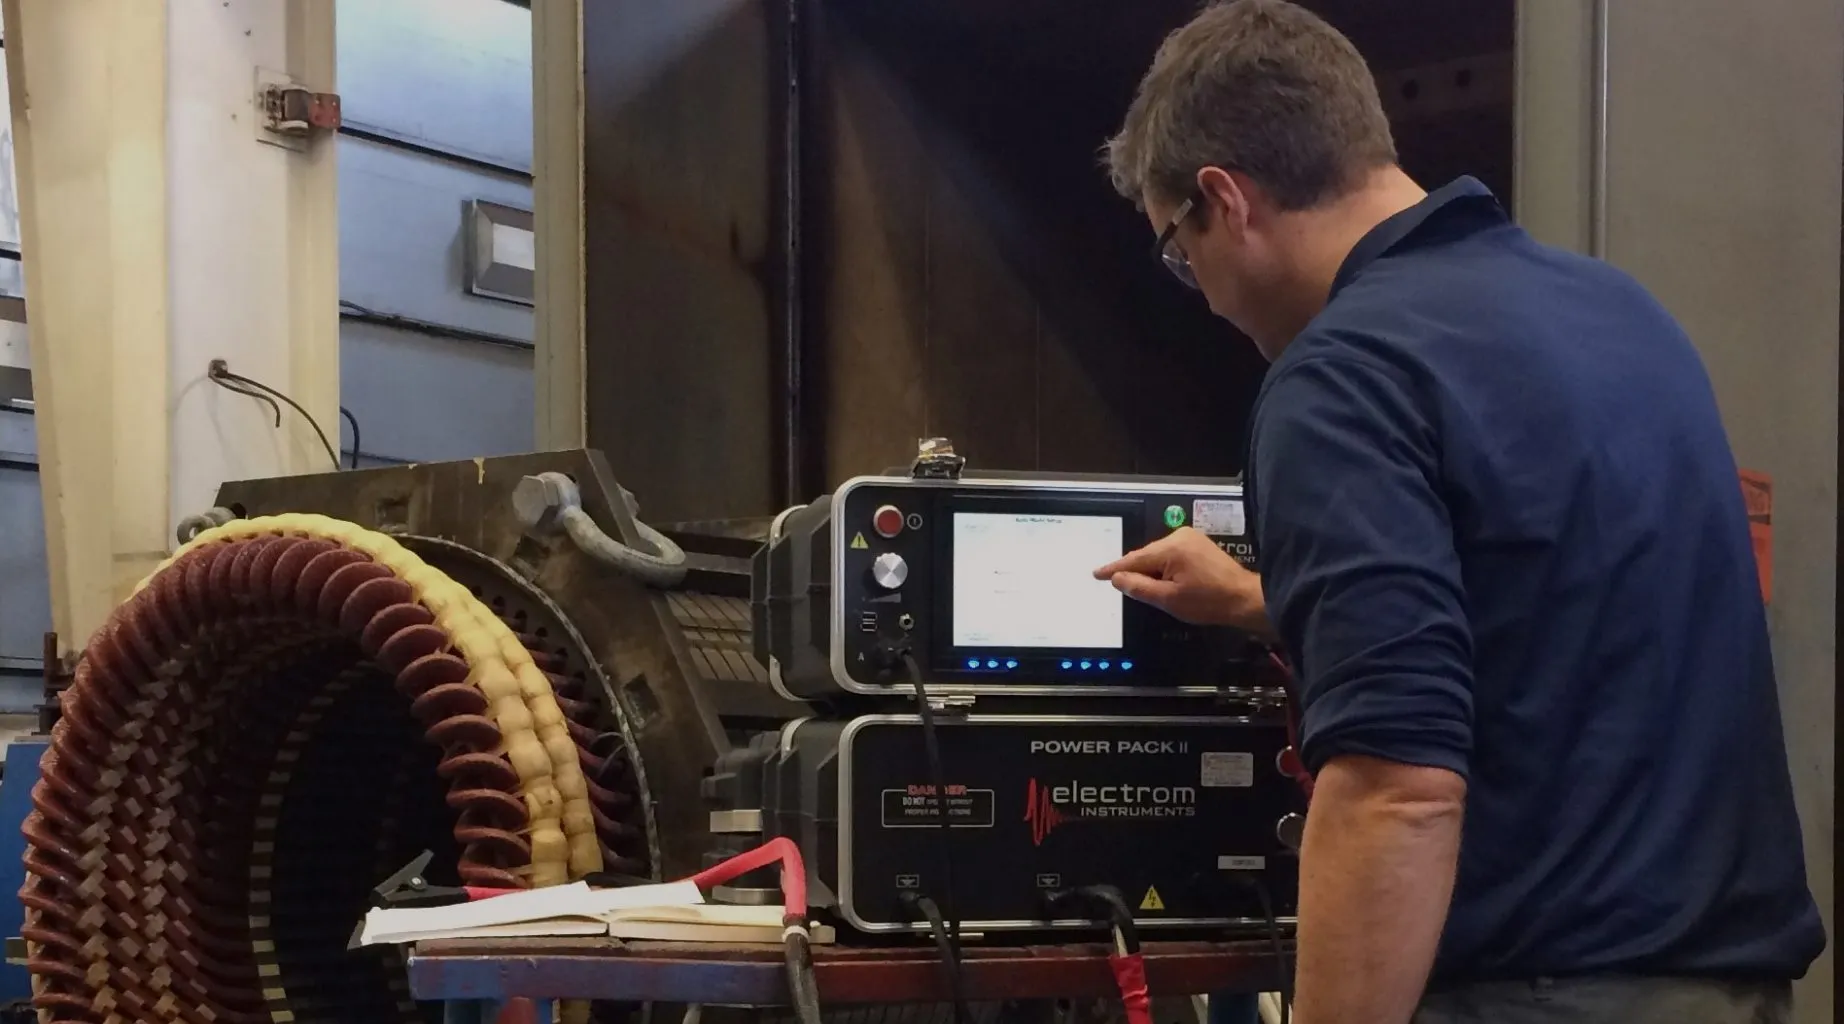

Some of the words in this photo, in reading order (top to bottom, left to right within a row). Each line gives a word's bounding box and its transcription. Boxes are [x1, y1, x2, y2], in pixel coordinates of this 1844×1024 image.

[1031, 741, 1111, 754] POWER
[1118, 741, 1175, 754] PACK
[1179, 741, 1189, 754] II
[907, 785, 968, 796] DANER
[1052, 780, 1196, 804] electrom
[1081, 806, 1196, 817] INSTRUMENTS
